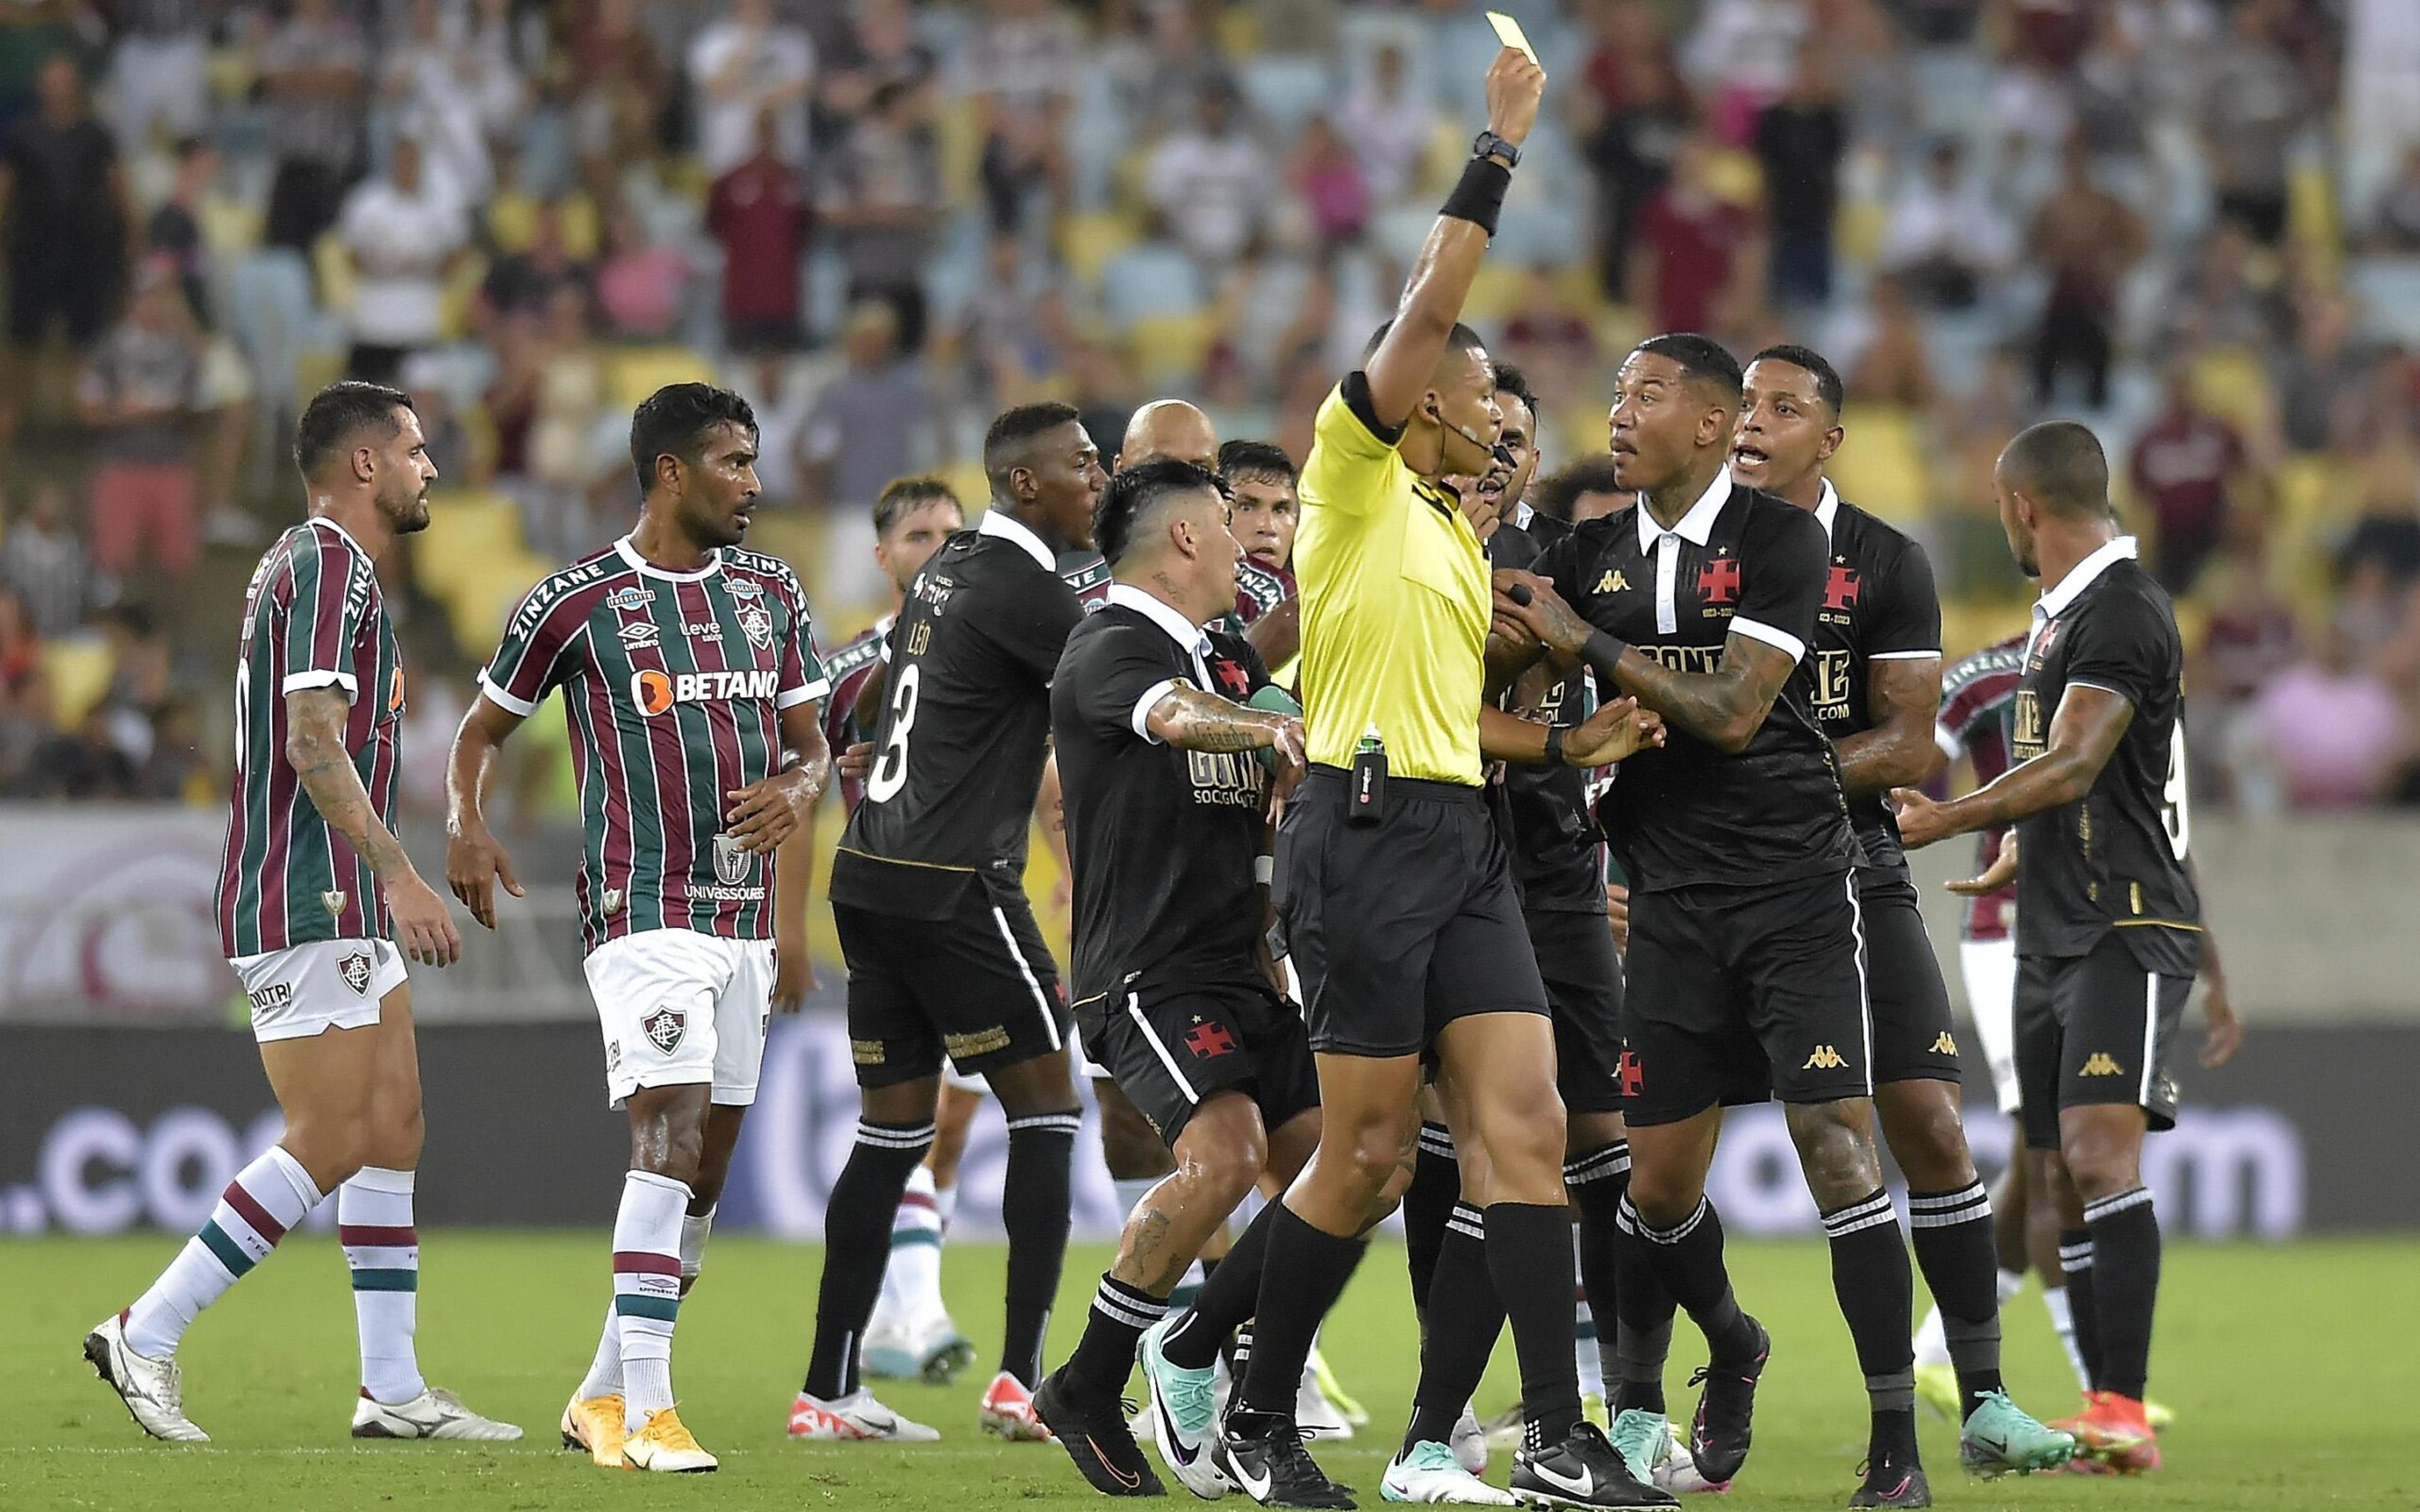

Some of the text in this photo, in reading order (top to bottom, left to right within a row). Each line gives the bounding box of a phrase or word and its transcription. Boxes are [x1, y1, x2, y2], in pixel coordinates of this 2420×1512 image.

[513, 564, 605, 643] ZINZANE
[624, 638, 659, 651] umbro
[679, 622, 721, 636] Leve
[908, 619, 931, 656] LÉO
[676, 670, 780, 702] BETANO
[867, 663, 919, 803] 3
